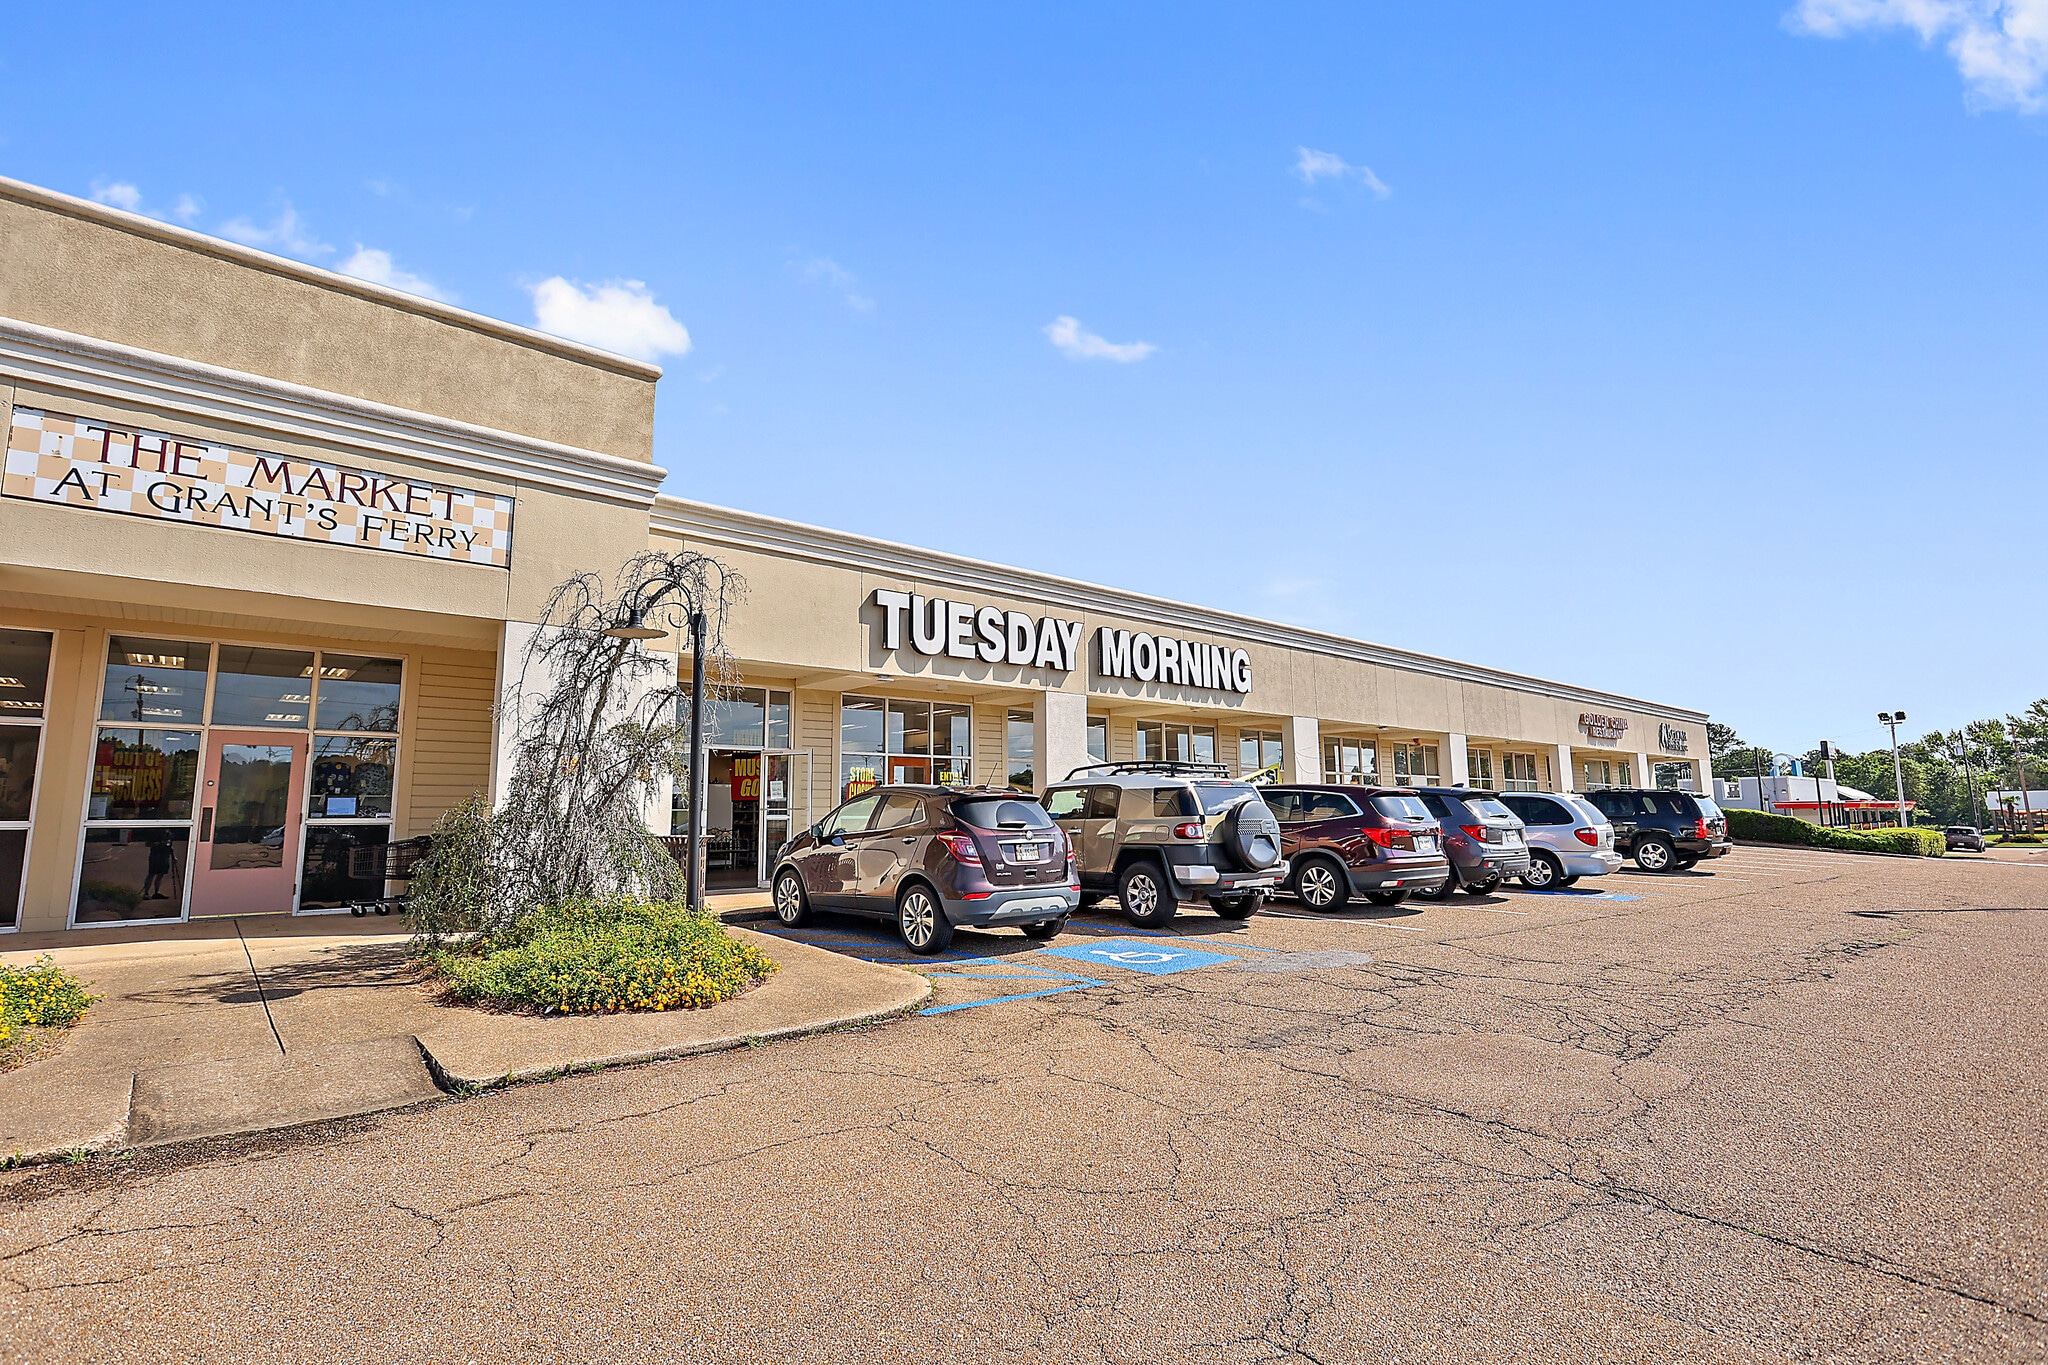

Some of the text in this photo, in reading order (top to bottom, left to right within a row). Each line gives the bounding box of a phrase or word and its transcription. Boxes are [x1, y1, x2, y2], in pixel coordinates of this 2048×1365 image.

[87, 425, 464, 522] THE MARKET
[50, 467, 480, 553] AT GRANT'S FERRY
[873, 588, 1253, 694] TUESDAY MORNING
[1584, 712, 1629, 730] GOLDEN CHINA
[113, 751, 162, 767] OUT OF
[849, 766, 875, 782] STORE
[740, 778, 760, 797] GO
